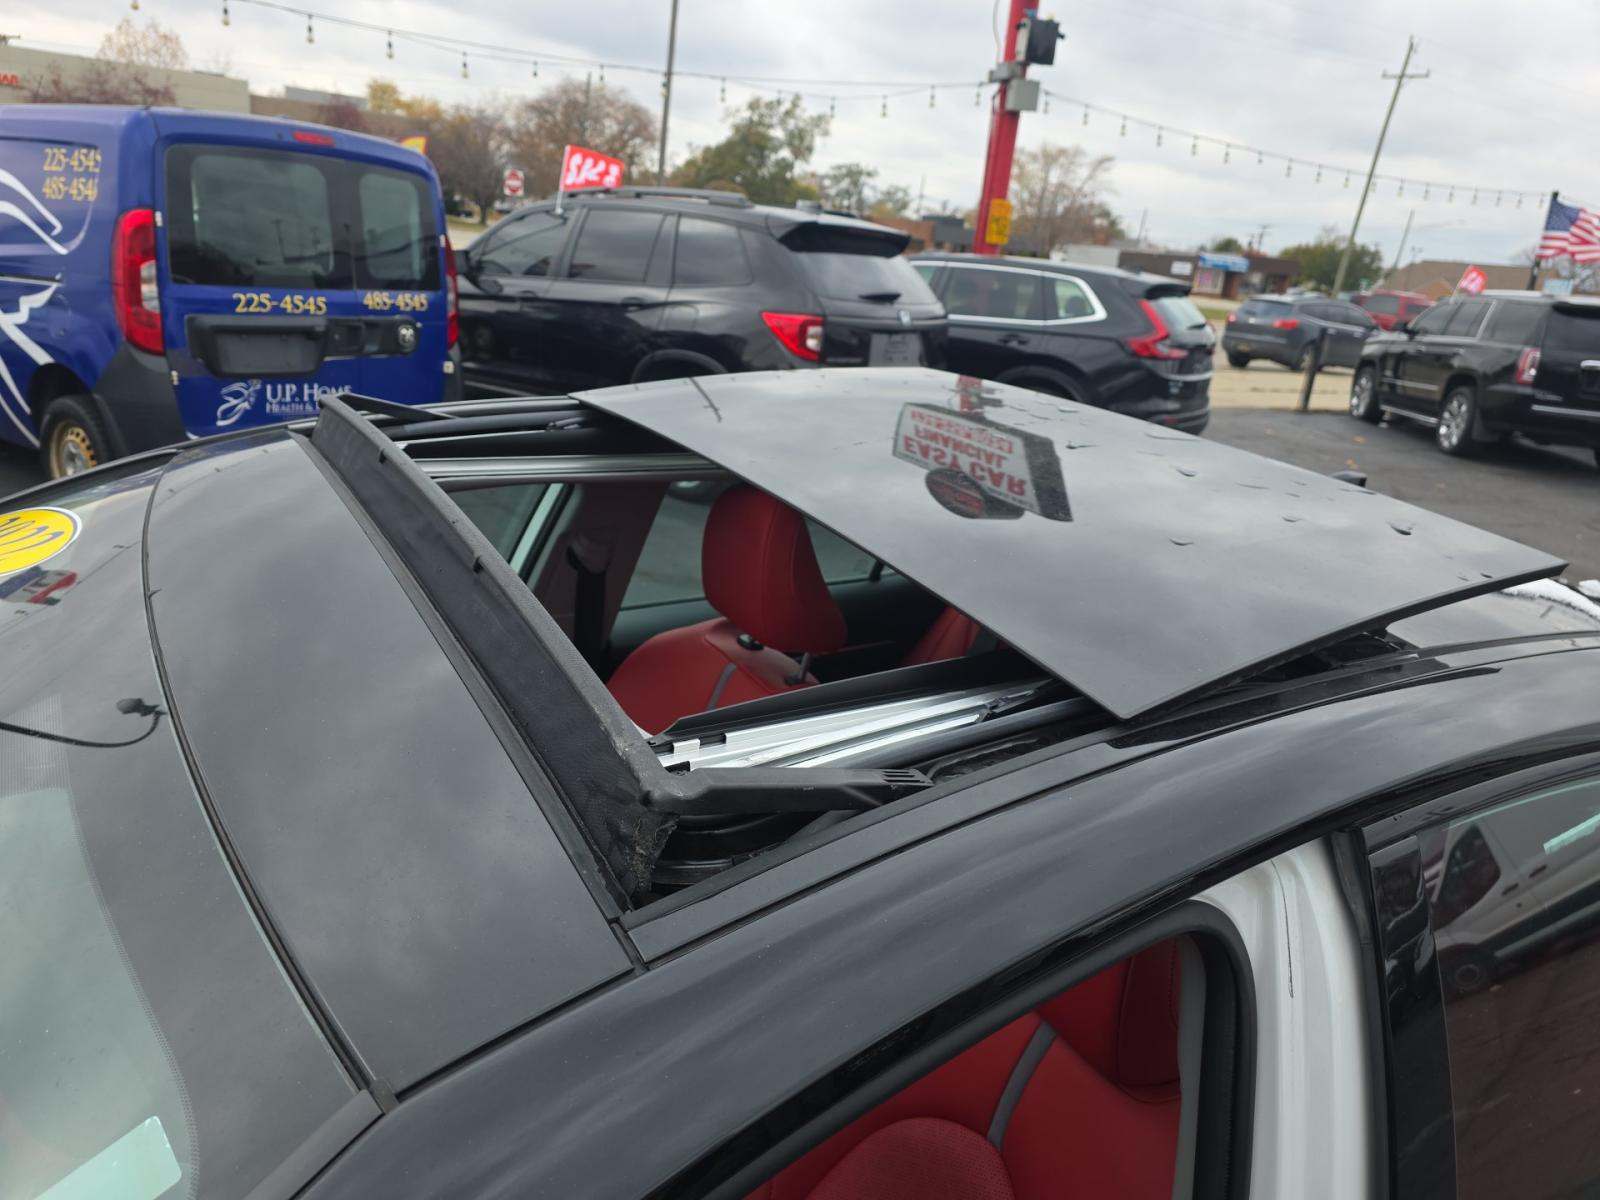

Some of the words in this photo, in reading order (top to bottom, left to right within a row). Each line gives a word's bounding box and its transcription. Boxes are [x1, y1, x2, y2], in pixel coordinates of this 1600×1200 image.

[232, 292, 328, 316] 225-4545
[363, 290, 429, 312] 485-4545
[265, 383, 299, 402] U.P.
